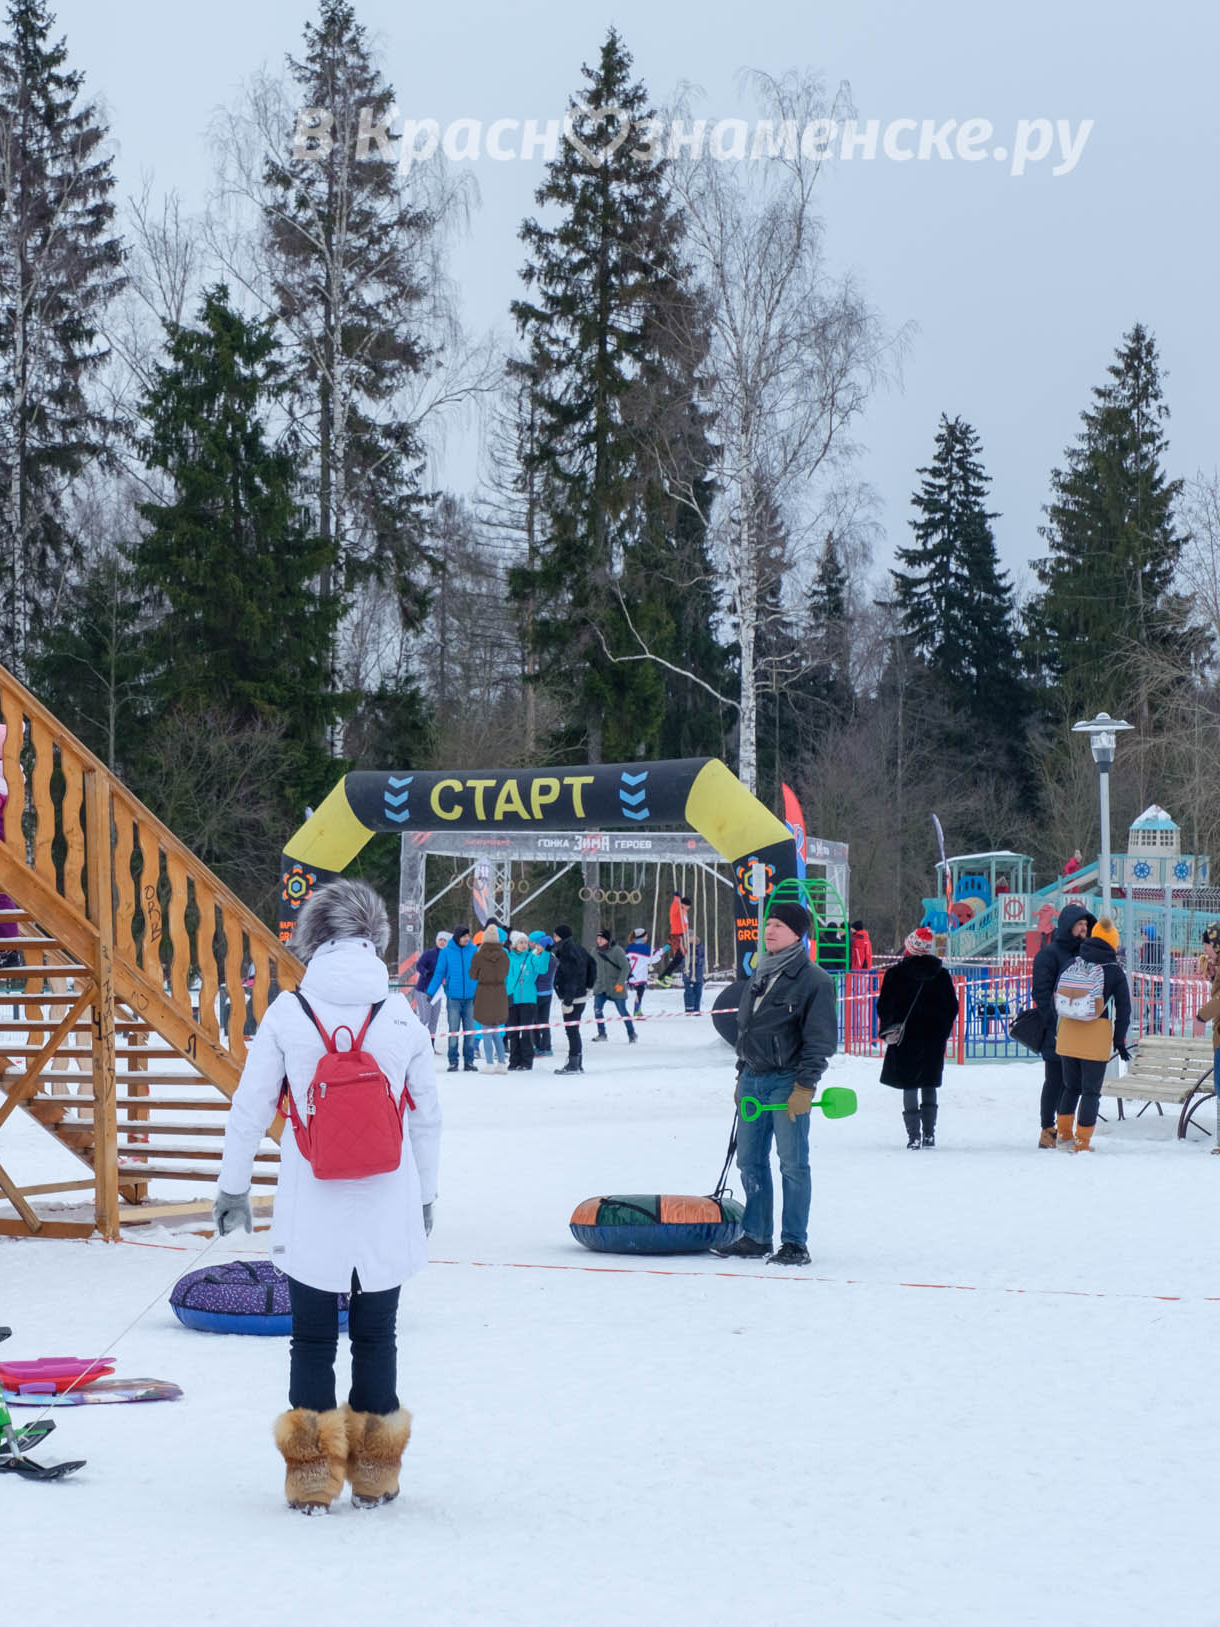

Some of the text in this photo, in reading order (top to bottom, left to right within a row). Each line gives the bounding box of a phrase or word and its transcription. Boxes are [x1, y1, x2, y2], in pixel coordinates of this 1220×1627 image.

[430, 776, 595, 821] СТАРТ
[537, 838, 570, 849] ГОНКА
[614, 839, 653, 850] ГЕРОЕВ
